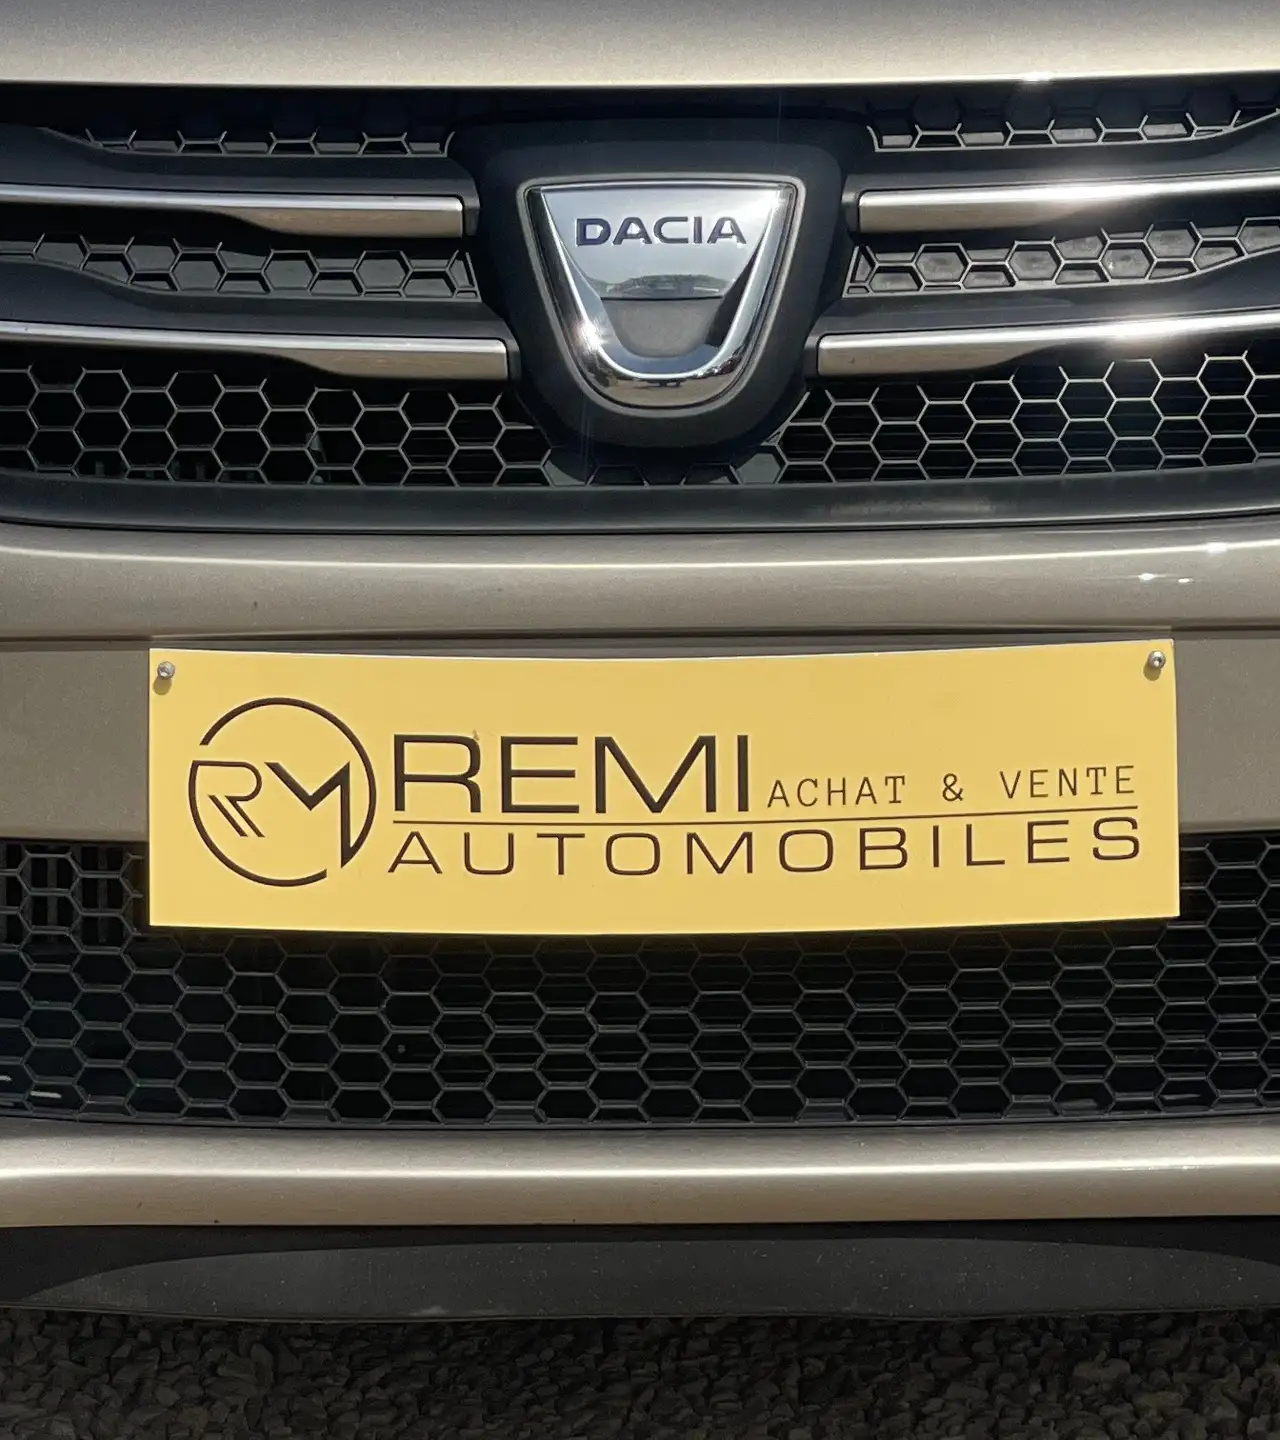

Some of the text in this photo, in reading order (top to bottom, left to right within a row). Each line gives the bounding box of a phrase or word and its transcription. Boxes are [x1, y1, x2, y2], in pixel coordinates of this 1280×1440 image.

[575, 215, 748, 247] DACIA
[393, 733, 1134, 814] REMI ACHAT & VENTE
[387, 816, 1140, 876] AUTOMOBILES
